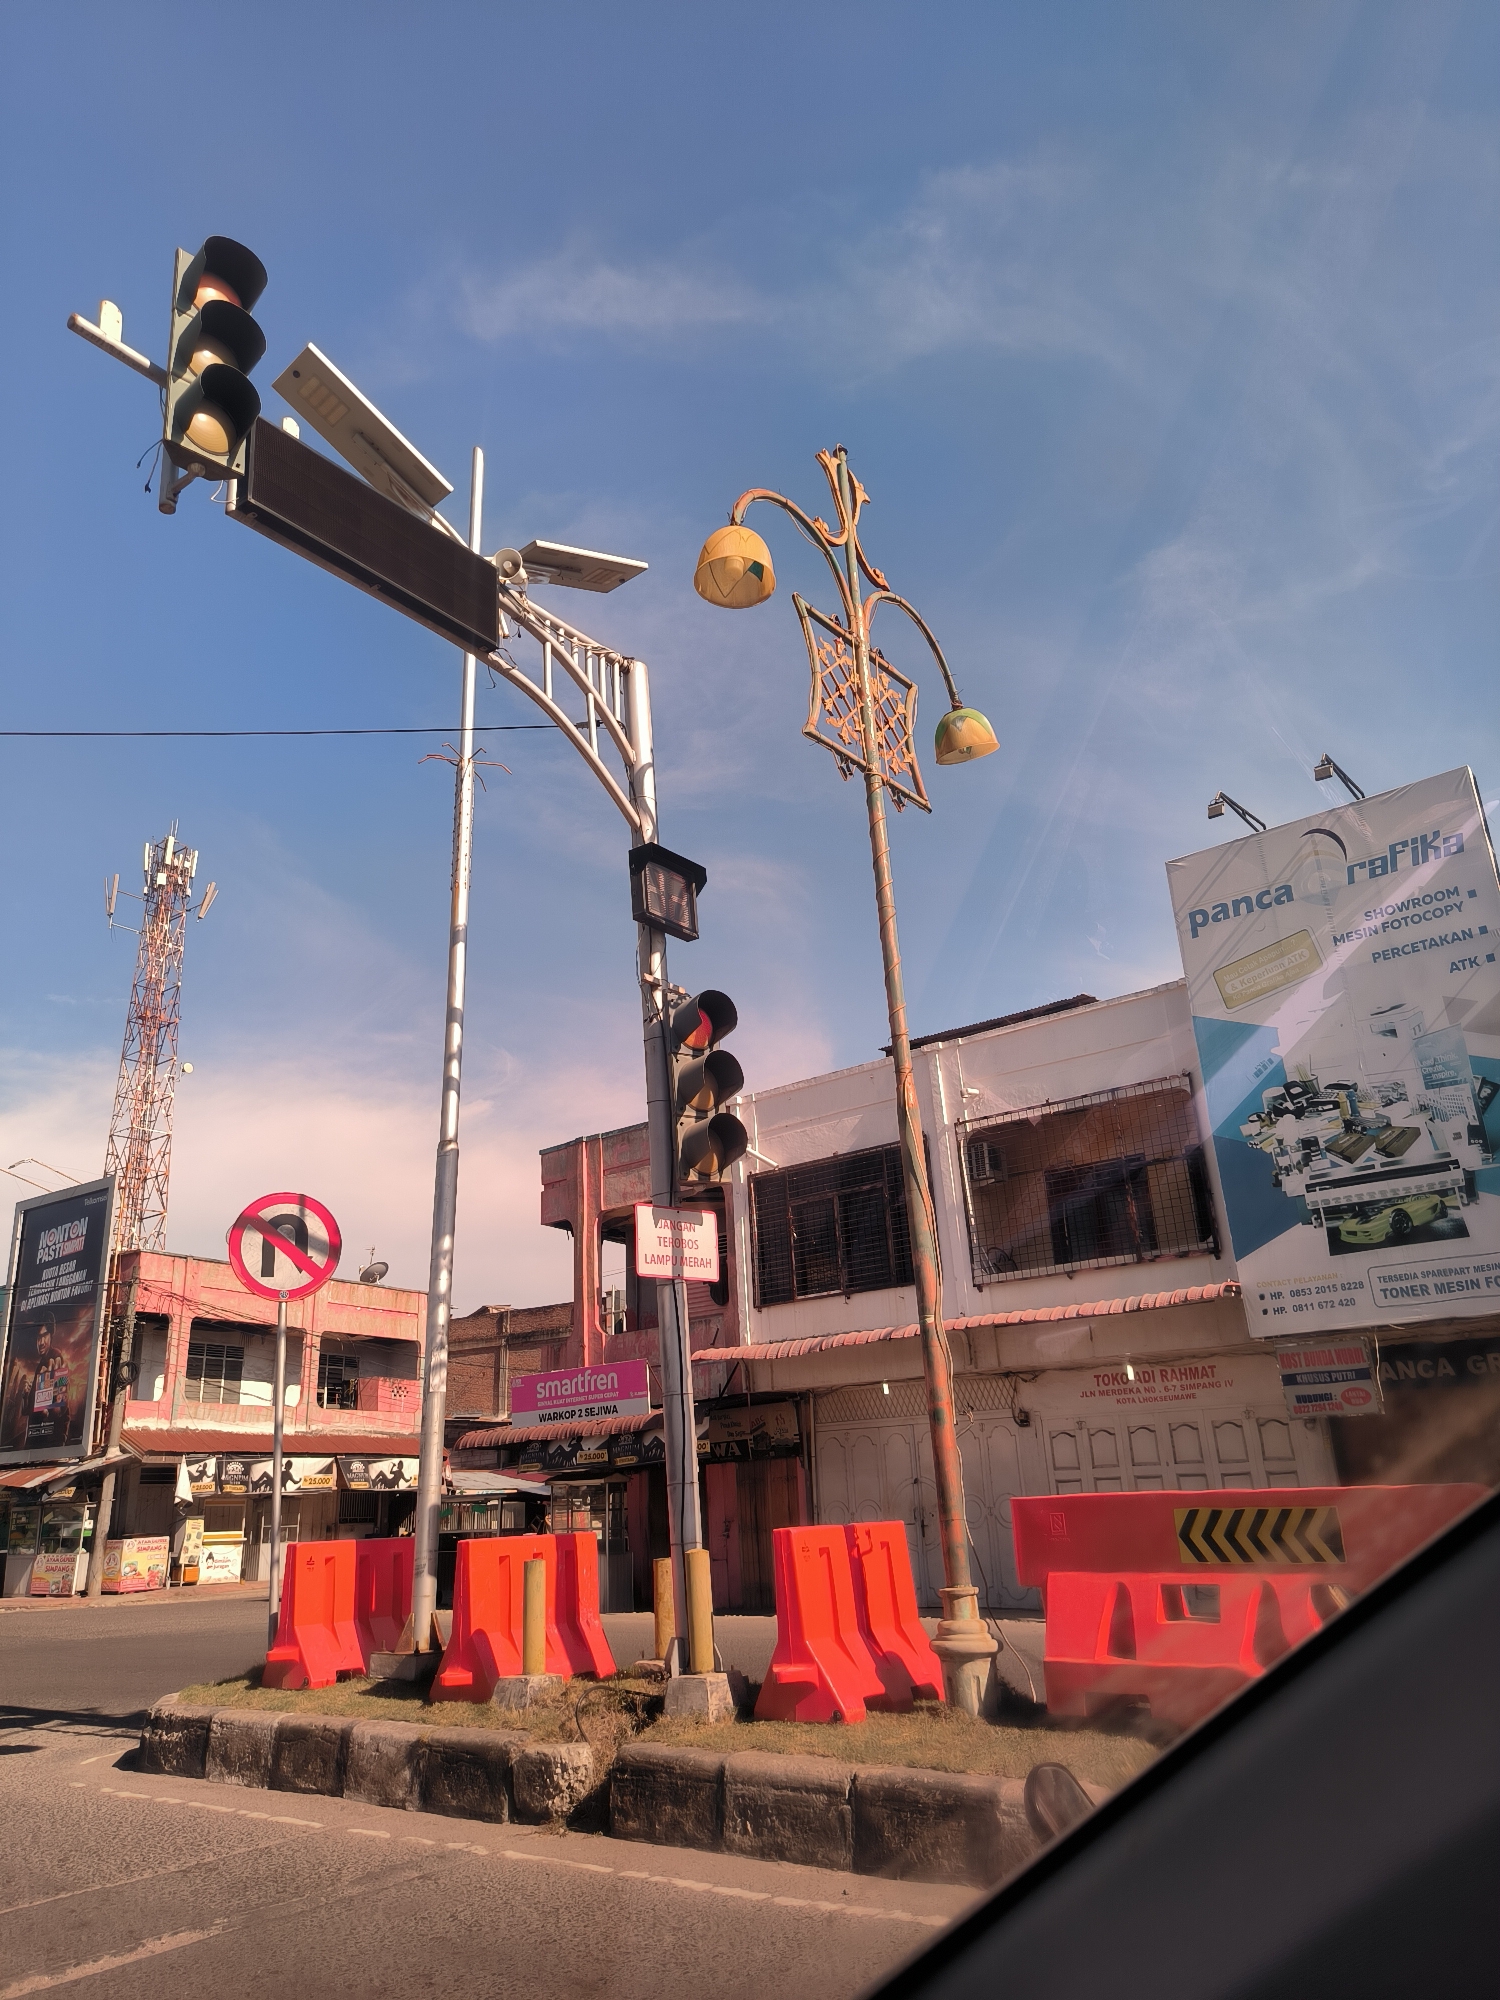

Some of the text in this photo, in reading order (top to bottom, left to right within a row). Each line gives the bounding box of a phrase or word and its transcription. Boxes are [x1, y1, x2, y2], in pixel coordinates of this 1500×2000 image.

[1188, 884, 1295, 939] panca
[1363, 886, 1460, 923] SHOWROOM
[1332, 900, 1465, 947] MESIN FOTOCOPY
[1371, 928, 1474, 964] PERCETAKAN
[1223, 971, 1239, 983] Mau
[1238, 960, 1259, 974] Cetak
[1230, 950, 1307, 991] & Keperluan ATK
[1449, 956, 1481, 974] ATK
[39, 1216, 89, 1250] NONTON
[658, 1219, 696, 1233] JANGAN
[656, 1235, 699, 1250] TEROBOS
[36, 1242, 63, 1265] PASTI
[644, 1253, 712, 1269] LAMPU MERAH
[41, 1259, 77, 1281] KUOTA BESAR
[1256, 1278, 1292, 1289] CONTACT
[1293, 1272, 1339, 1286] PELAYANAN
[1377, 1261, 1500, 1284] TERSEDIA SPAREPART MESIN
[27, 1294, 50, 1310] APLIKASI
[49, 1287, 71, 1304] NONTON
[1269, 1280, 1365, 1301] HP. 0853 2015 8228
[1379, 1283, 1432, 1300] TONER
[1433, 1278, 1481, 1295] MESIN
[1272, 1297, 1356, 1316] HP. 0811 672 420
[1278, 1351, 1303, 1370] KOST
[1302, 1349, 1336, 1368] BUNDA
[1380, 1357, 1456, 1382] ANCA
[536, 1369, 619, 1399] smartfren
[1093, 1364, 1217, 1388] TOKO ADI RAHMAT
[1295, 1370, 1356, 1384] KHUSUS PUTRI
[566, 1395, 588, 1403] INTERNET
[1080, 1390, 1096, 1399] JLN
[1098, 1386, 1142, 1397] MERDEKA
[1164, 1384, 1177, 1393] 6-7
[1179, 1380, 1222, 1392] SIMPANG
[1224, 1380, 1234, 1388] IV
[1116, 1392, 1198, 1406] KOTA LHOKSEUMAWE
[1295, 1392, 1333, 1404] HUBUNGI
[538, 1404, 619, 1423] WARKOP 2 SEJIWA
[751, 1415, 765, 1427] ABC
